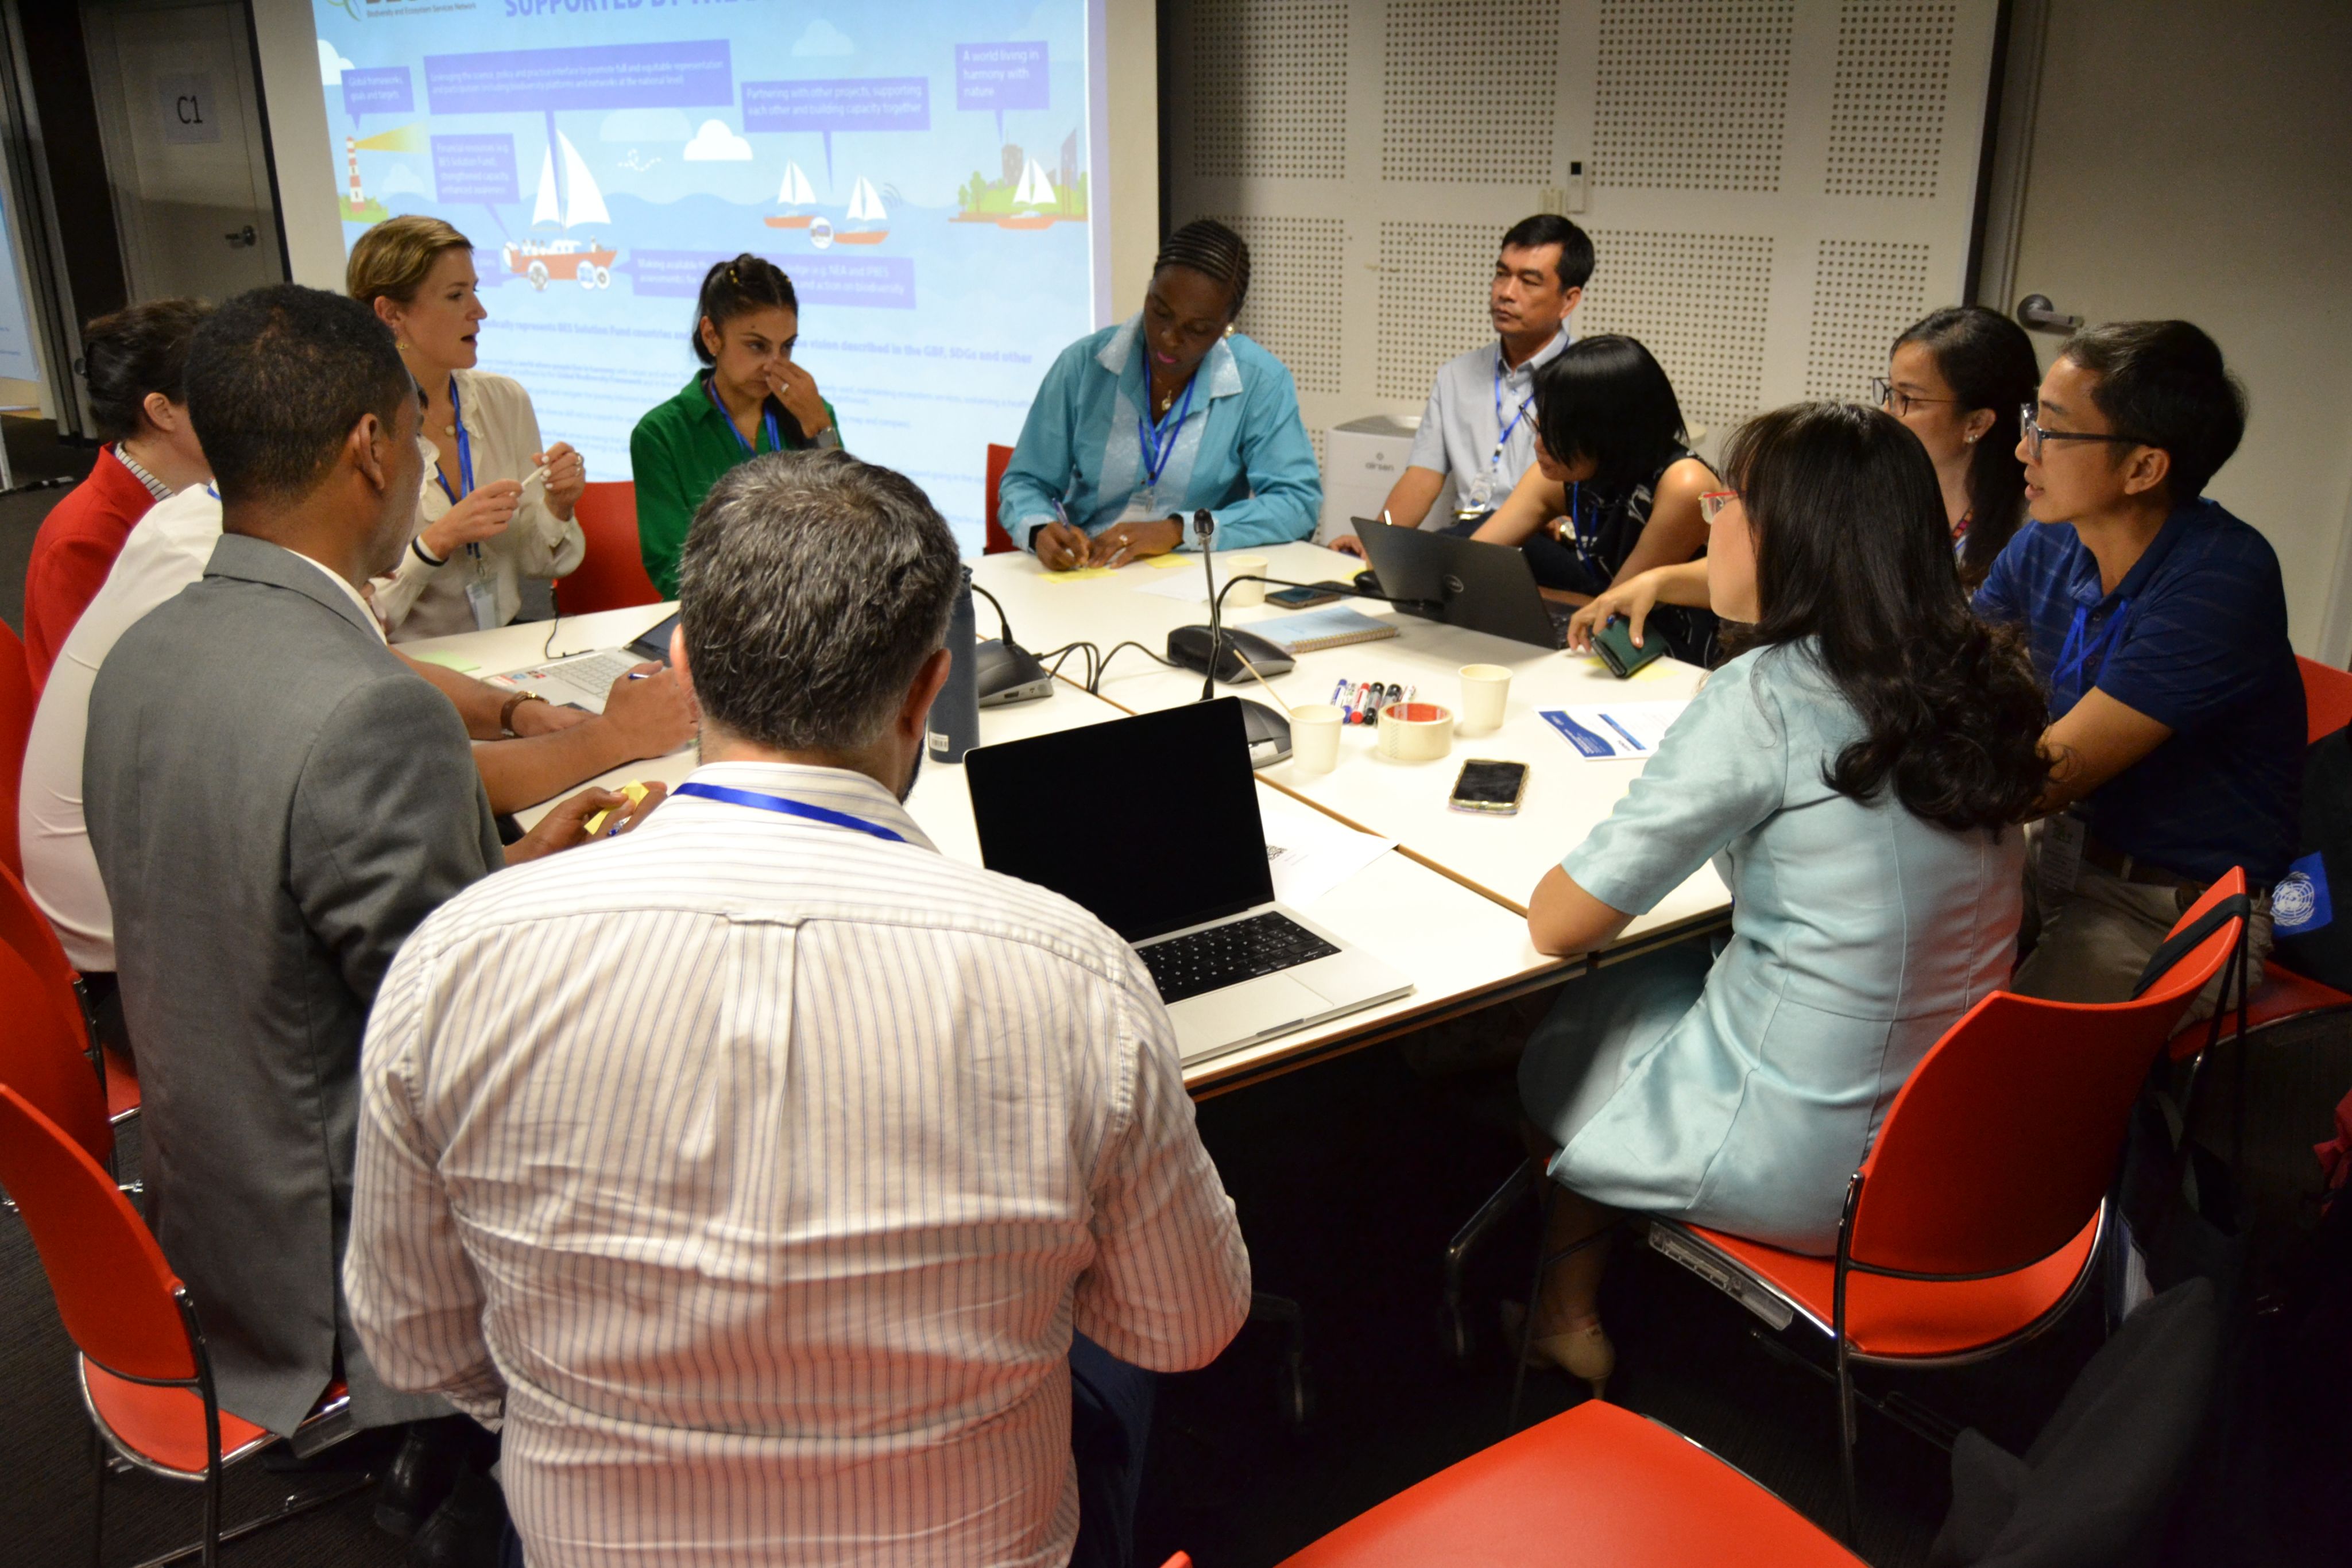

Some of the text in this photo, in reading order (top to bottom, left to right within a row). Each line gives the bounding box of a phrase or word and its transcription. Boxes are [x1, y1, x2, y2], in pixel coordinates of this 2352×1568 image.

[366, 9, 393, 18] Biodiversity
[405, 6, 431, 15] Ecosystem
[432, 4, 453, 12] Services
[454, 2, 476, 10] Network
[963, 48, 1039, 64] A world living in
[963, 67, 1030, 82] harmony with
[746, 87, 790, 100] Partnering
[790, 88, 810, 98] with
[810, 86, 833, 98] other
[872, 84, 922, 98] supporting
[964, 87, 995, 97] nature
[177, 95, 203, 124] C1
[748, 101, 922, 116] each other and building capacity together
[637, 258, 665, 272] Making
[666, 258, 698, 269] available
[515, 320, 556, 333] represents
[557, 322, 572, 332] BES
[574, 322, 608, 335] Solution
[609, 324, 631, 336] Fund
[632, 327, 672, 339] countries
[809, 338, 839, 351] vision
[840, 339, 890, 355] described
[891, 343, 903, 355] in
[904, 343, 922, 356] the
[949, 346, 978, 360] SDGs
[979, 348, 1000, 362] and
[1001, 350, 1033, 365] other
